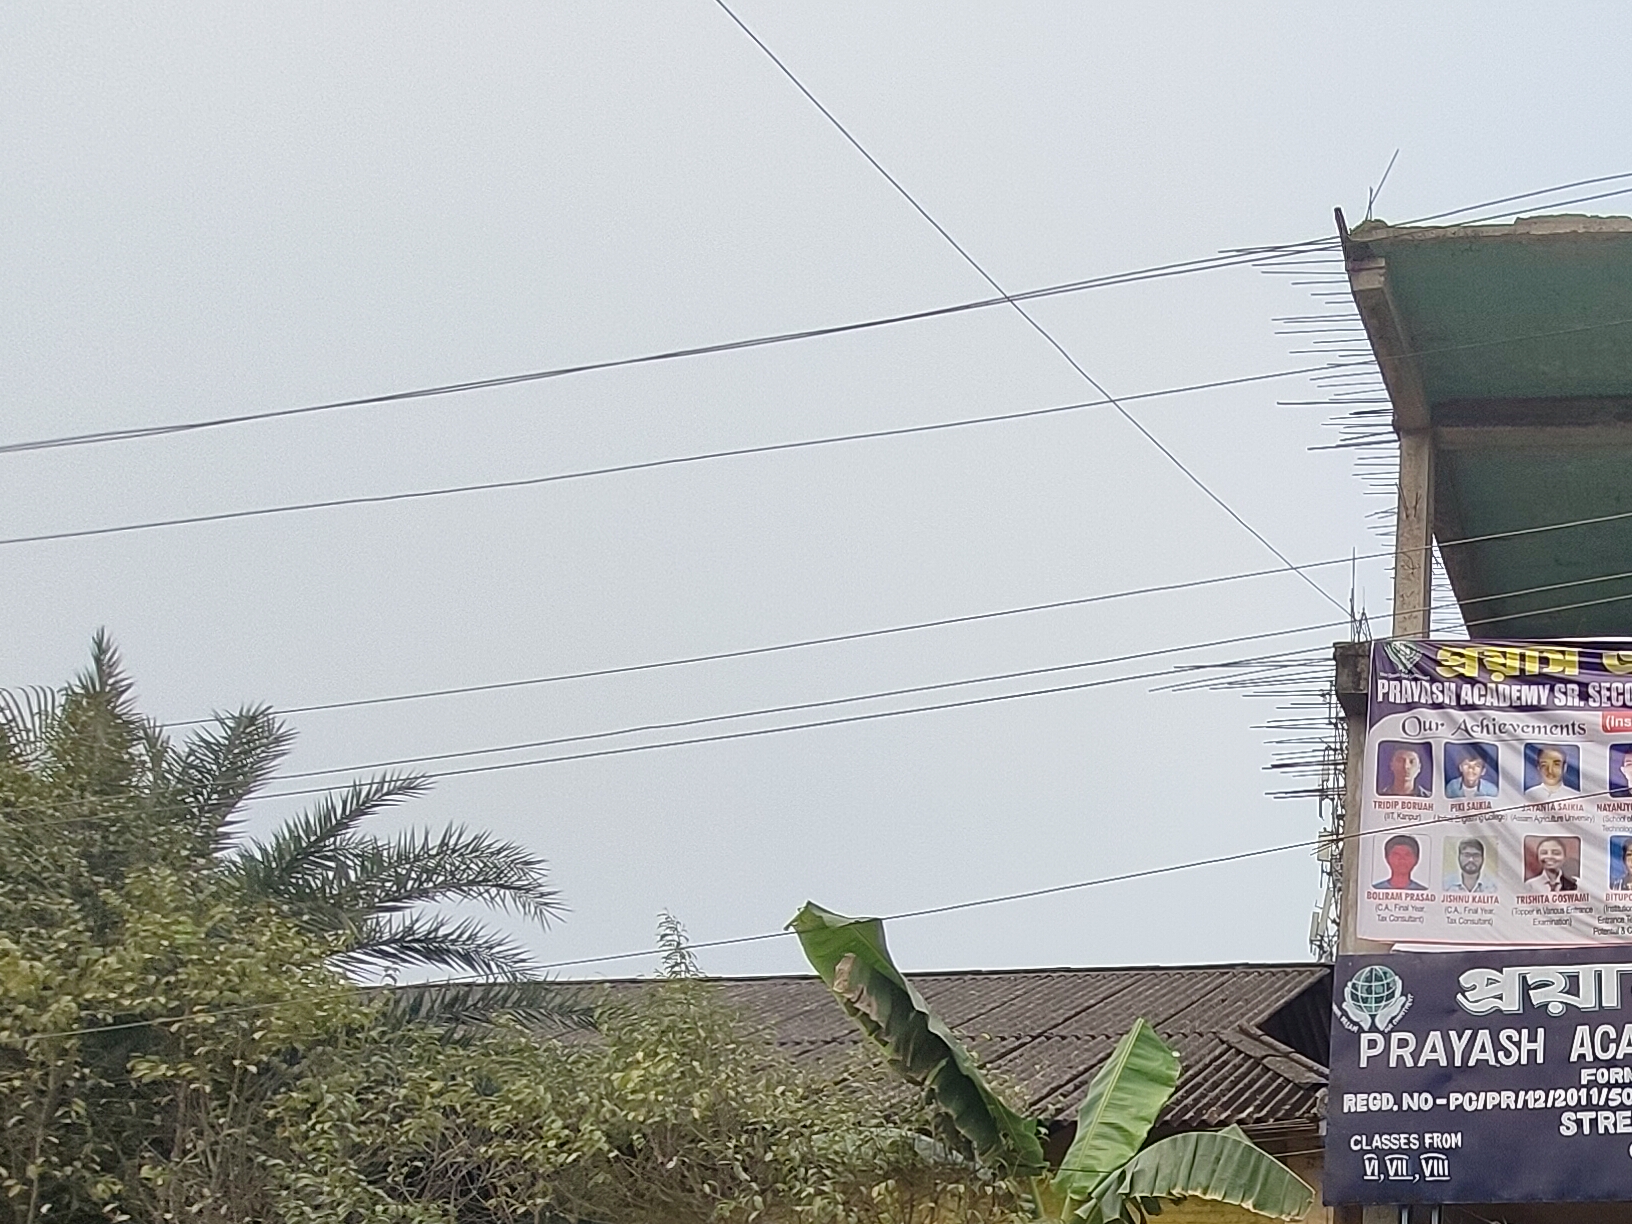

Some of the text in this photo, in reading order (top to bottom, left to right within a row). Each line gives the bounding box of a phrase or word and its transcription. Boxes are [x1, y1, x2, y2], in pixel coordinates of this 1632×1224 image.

[1377, 680, 1456, 705] PRAYASH
[1460, 683, 1549, 707] ACADEMY
[1554, 683, 1584, 707] SR.
[1401, 715, 1586, 737] Our Achievements
[1373, 801, 1434, 811] TRIDIP BORUAH
[1405, 893, 1436, 902] PRASAD
[1472, 895, 1499, 904] KALITA
[1358, 1027, 1546, 1068] PRAYASH
[1343, 1092, 1398, 1113] REGD.
[1350, 1132, 1462, 1150] CLASSES FROM
